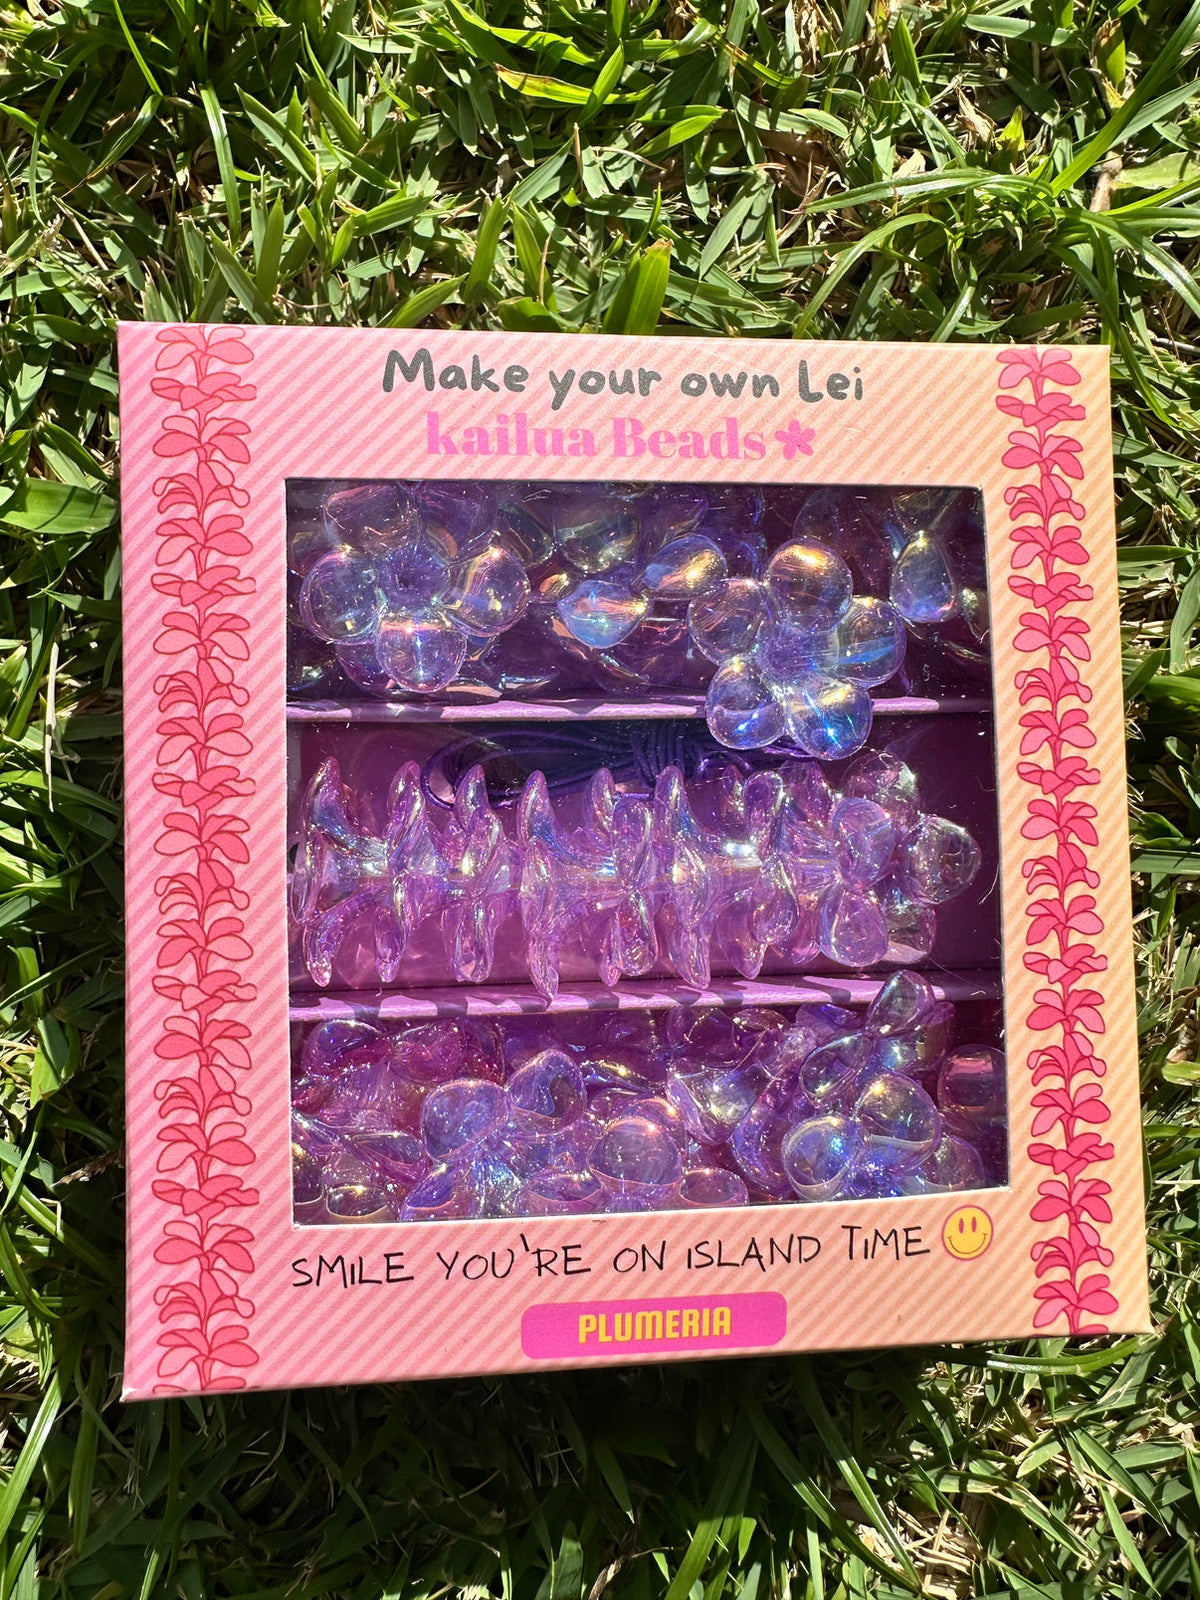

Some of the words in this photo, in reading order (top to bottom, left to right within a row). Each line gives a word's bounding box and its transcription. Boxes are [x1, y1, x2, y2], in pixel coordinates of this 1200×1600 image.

[382, 348, 529, 393] Make
[549, 367, 662, 410] your
[680, 370, 780, 398] own
[798, 359, 864, 403] Lei
[426, 411, 600, 457] kailua
[611, 416, 767, 461] Beads
[436, 1233, 592, 1281] YOU'RE
[613, 1240, 667, 1273] ON
[578, 1306, 732, 1344] PLUMERIA
